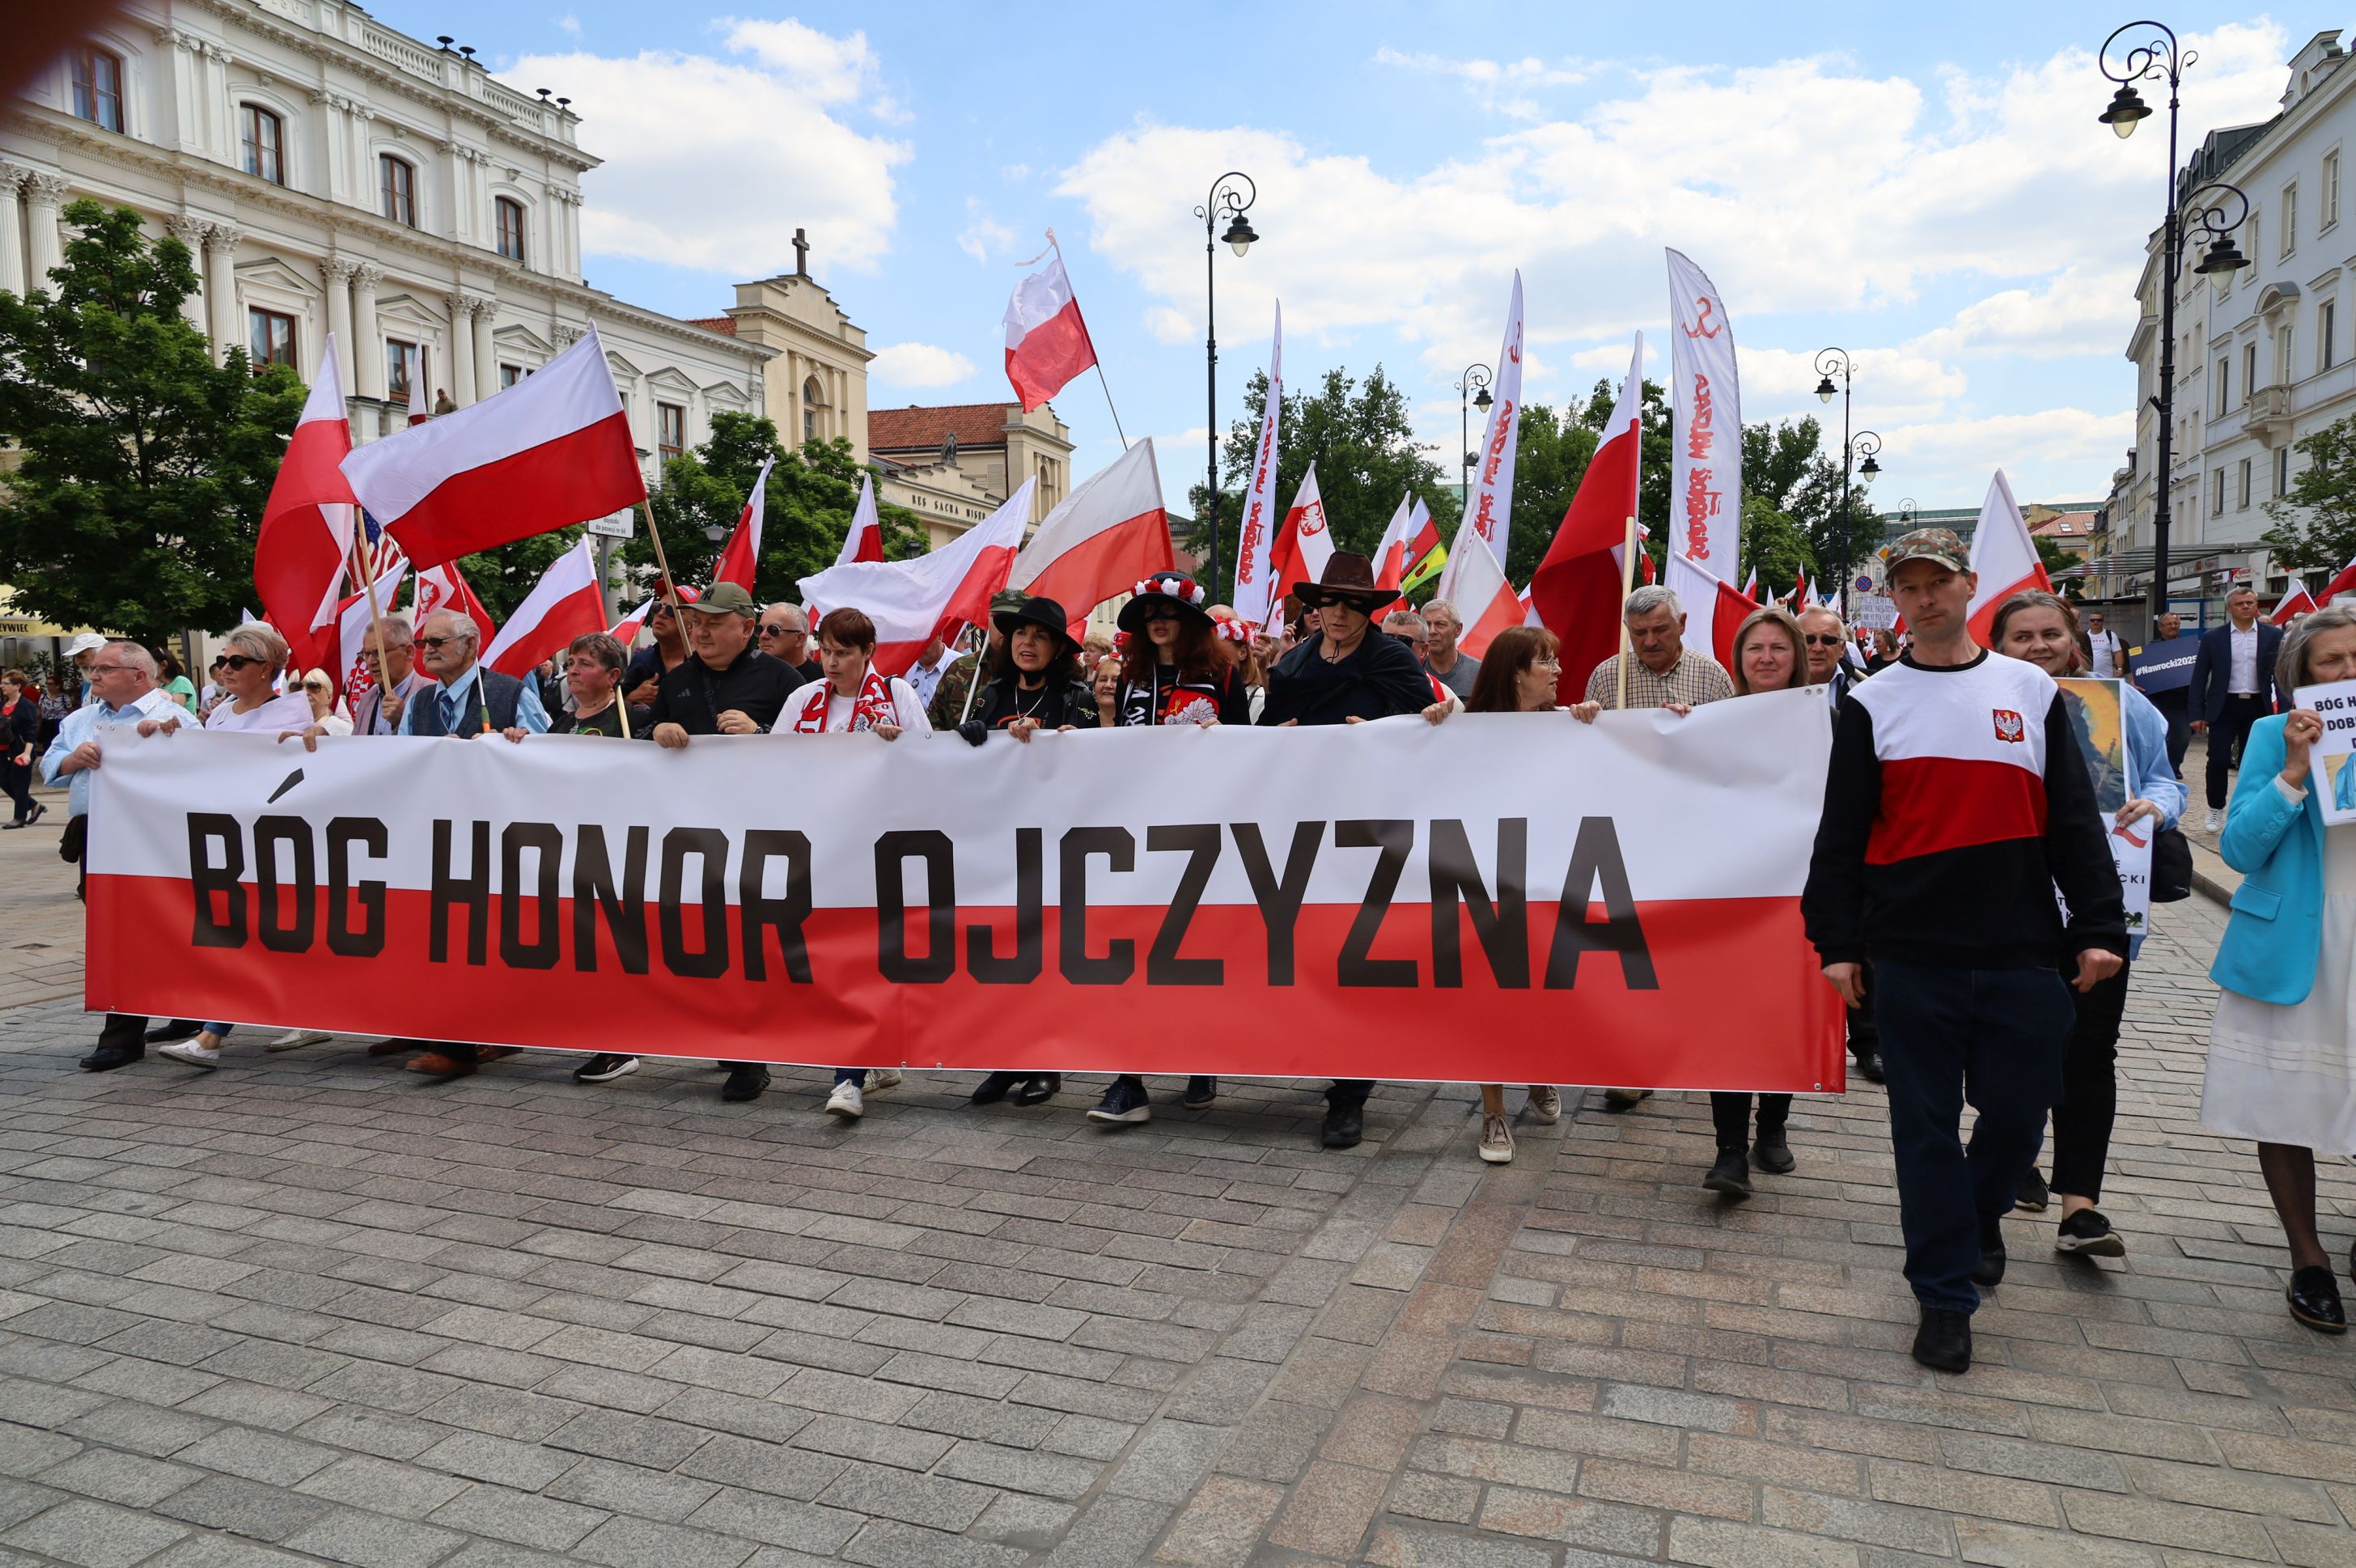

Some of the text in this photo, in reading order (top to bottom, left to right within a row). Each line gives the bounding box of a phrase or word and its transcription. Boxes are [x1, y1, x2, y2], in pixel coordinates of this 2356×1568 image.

[912, 494, 926, 506] RES
[934, 500, 959, 515] SACRA
[2315, 697, 2344, 712] BÓG
[2327, 717, 2356, 731] DOB
[187, 768, 1659, 990] BÓG HONOR OJCZYZNA
